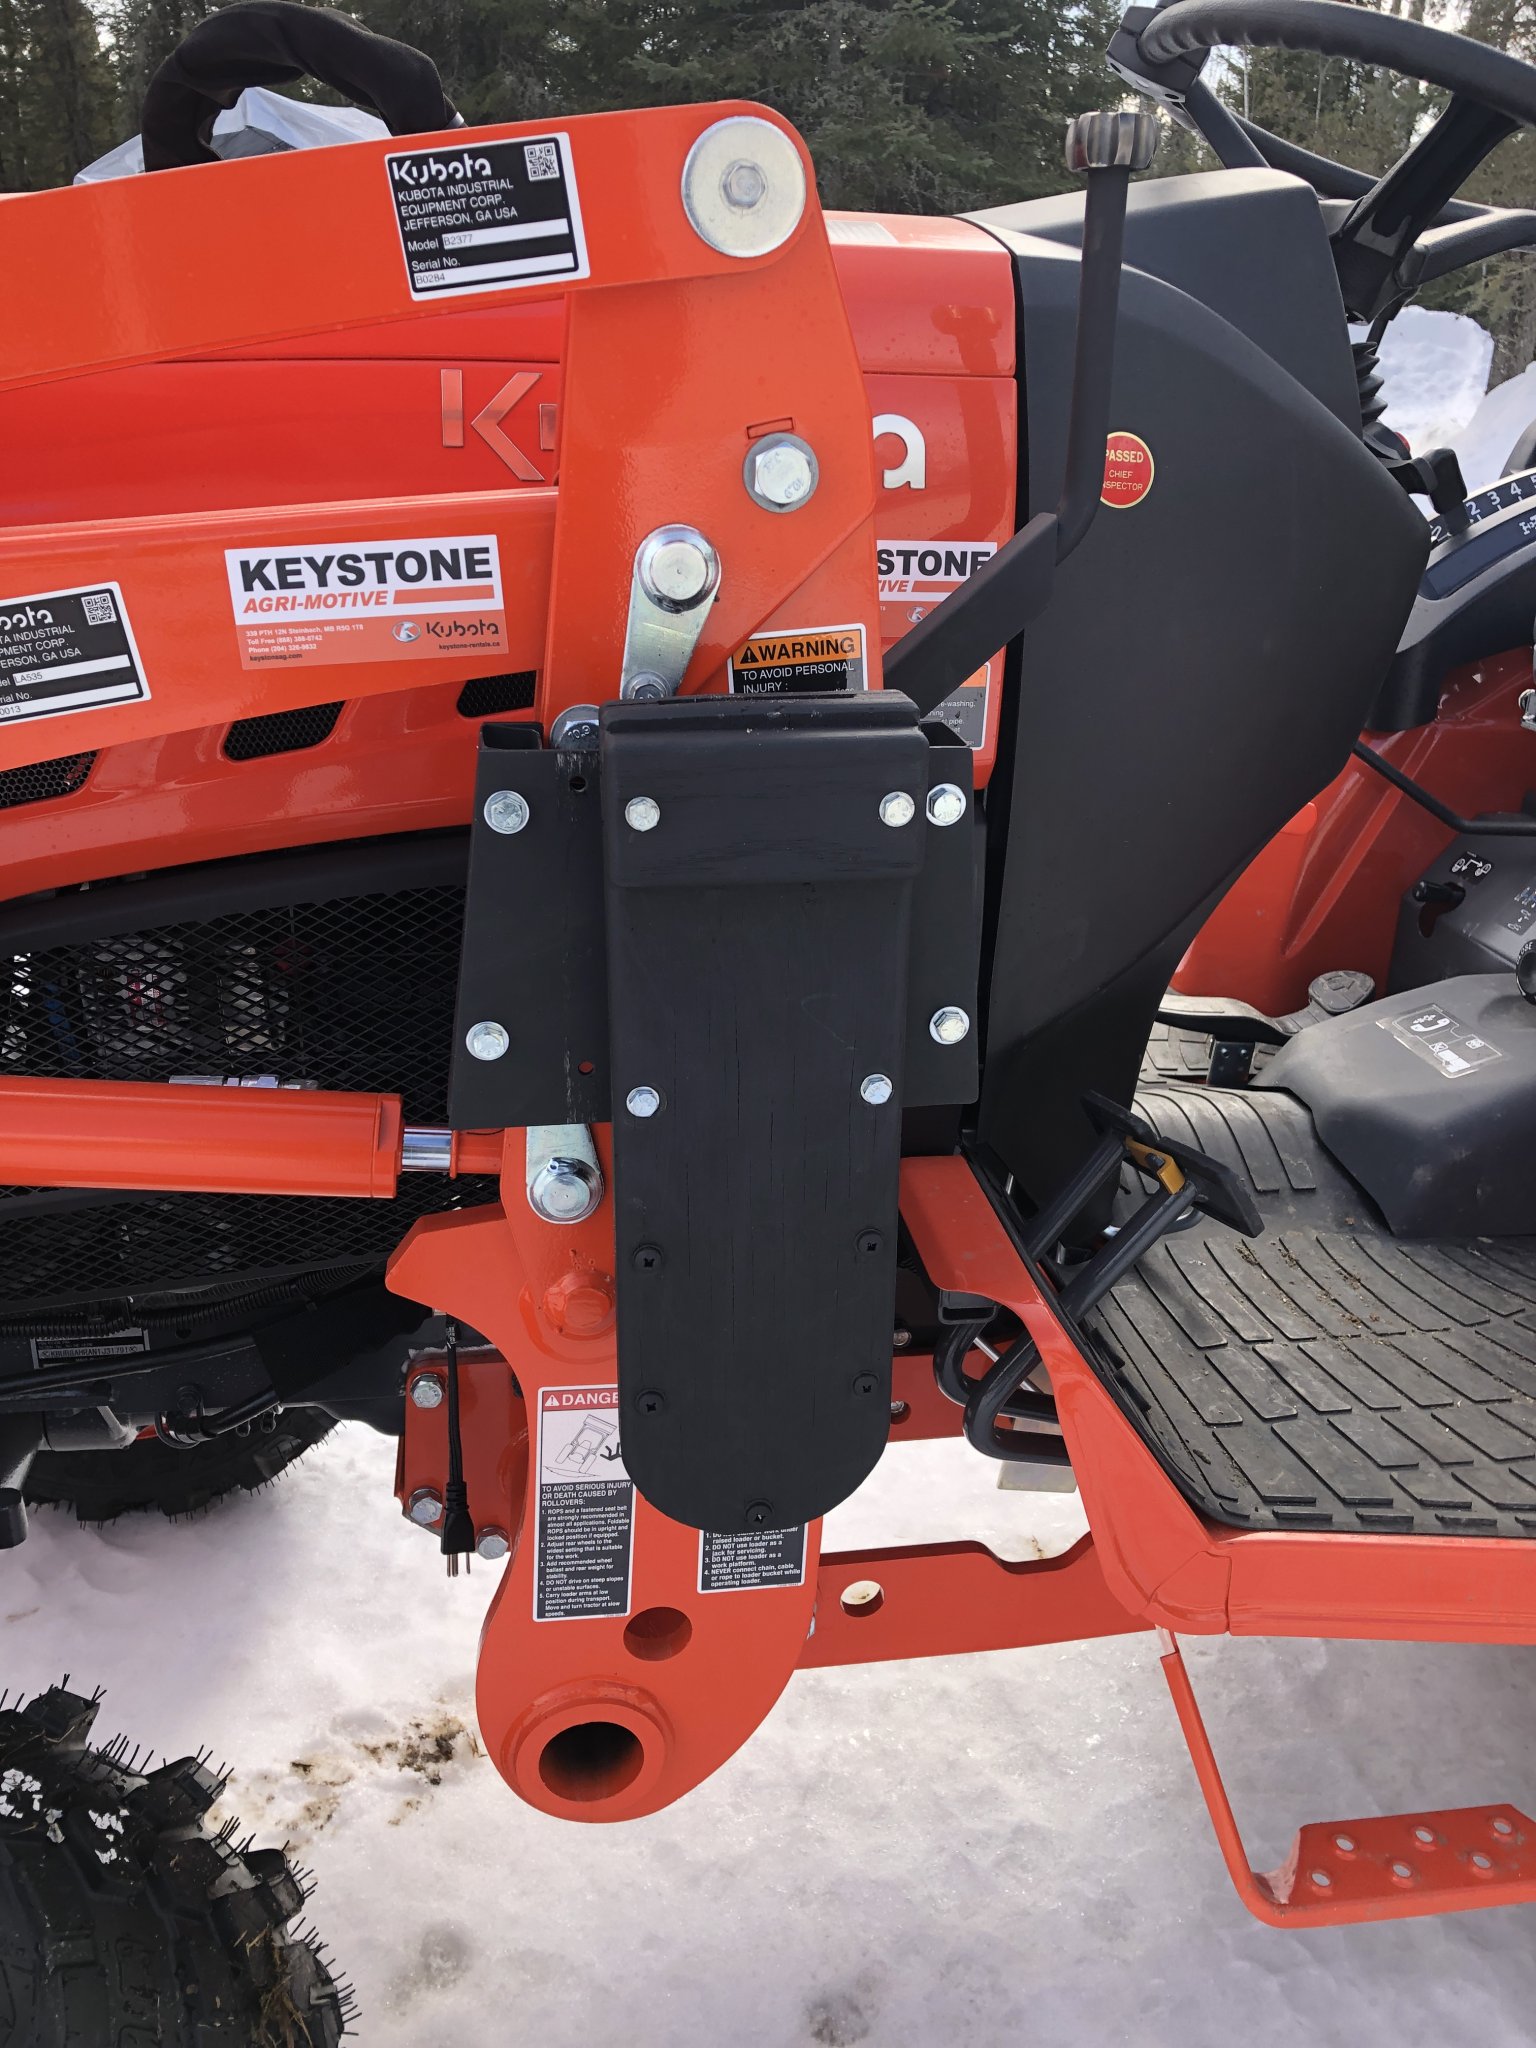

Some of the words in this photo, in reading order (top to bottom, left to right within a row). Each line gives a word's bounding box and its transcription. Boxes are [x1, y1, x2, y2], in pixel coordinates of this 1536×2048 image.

[392, 153, 492, 185] Kubota
[398, 187, 448, 202] KUBOTA
[447, 178, 513, 195] INDUSTRIAL
[401, 198, 467, 217] EQUIPMENT
[470, 194, 505, 208] CORP.
[404, 214, 473, 231] JEFFERSON,
[476, 210, 492, 221] GA
[495, 206, 518, 218] USA
[408, 238, 438, 251] Model
[444, 234, 472, 246] B2377
[412, 259, 440, 271] Serial
[443, 257, 460, 267] No.
[1109, 470, 1133, 478] CHIEF
[1103, 481, 1143, 490] SPECTOR
[1466, 501, 1480, 516] 2
[1487, 491, 1500, 505] 3
[1510, 482, 1521, 495] 4
[240, 546, 493, 592] KEYSTONE
[878, 550, 990, 576] STONE
[243, 590, 388, 614] AGRI-MOTIVE
[13, 625, 75, 641] INDUSTRIAL
[426, 619, 499, 637] Kubota
[36, 638, 68, 650] CORP.
[759, 636, 855, 662] WARNING
[42, 651, 58, 661] GA
[60, 648, 81, 658] USA
[15, 672, 43, 683] LA535
[742, 671, 757, 680] TO
[760, 668, 792, 679] AVOID
[796, 662, 854, 675] PERSONAL
[16, 692, 32, 700] No.
[563, 1393, 618, 1405] DANGE
